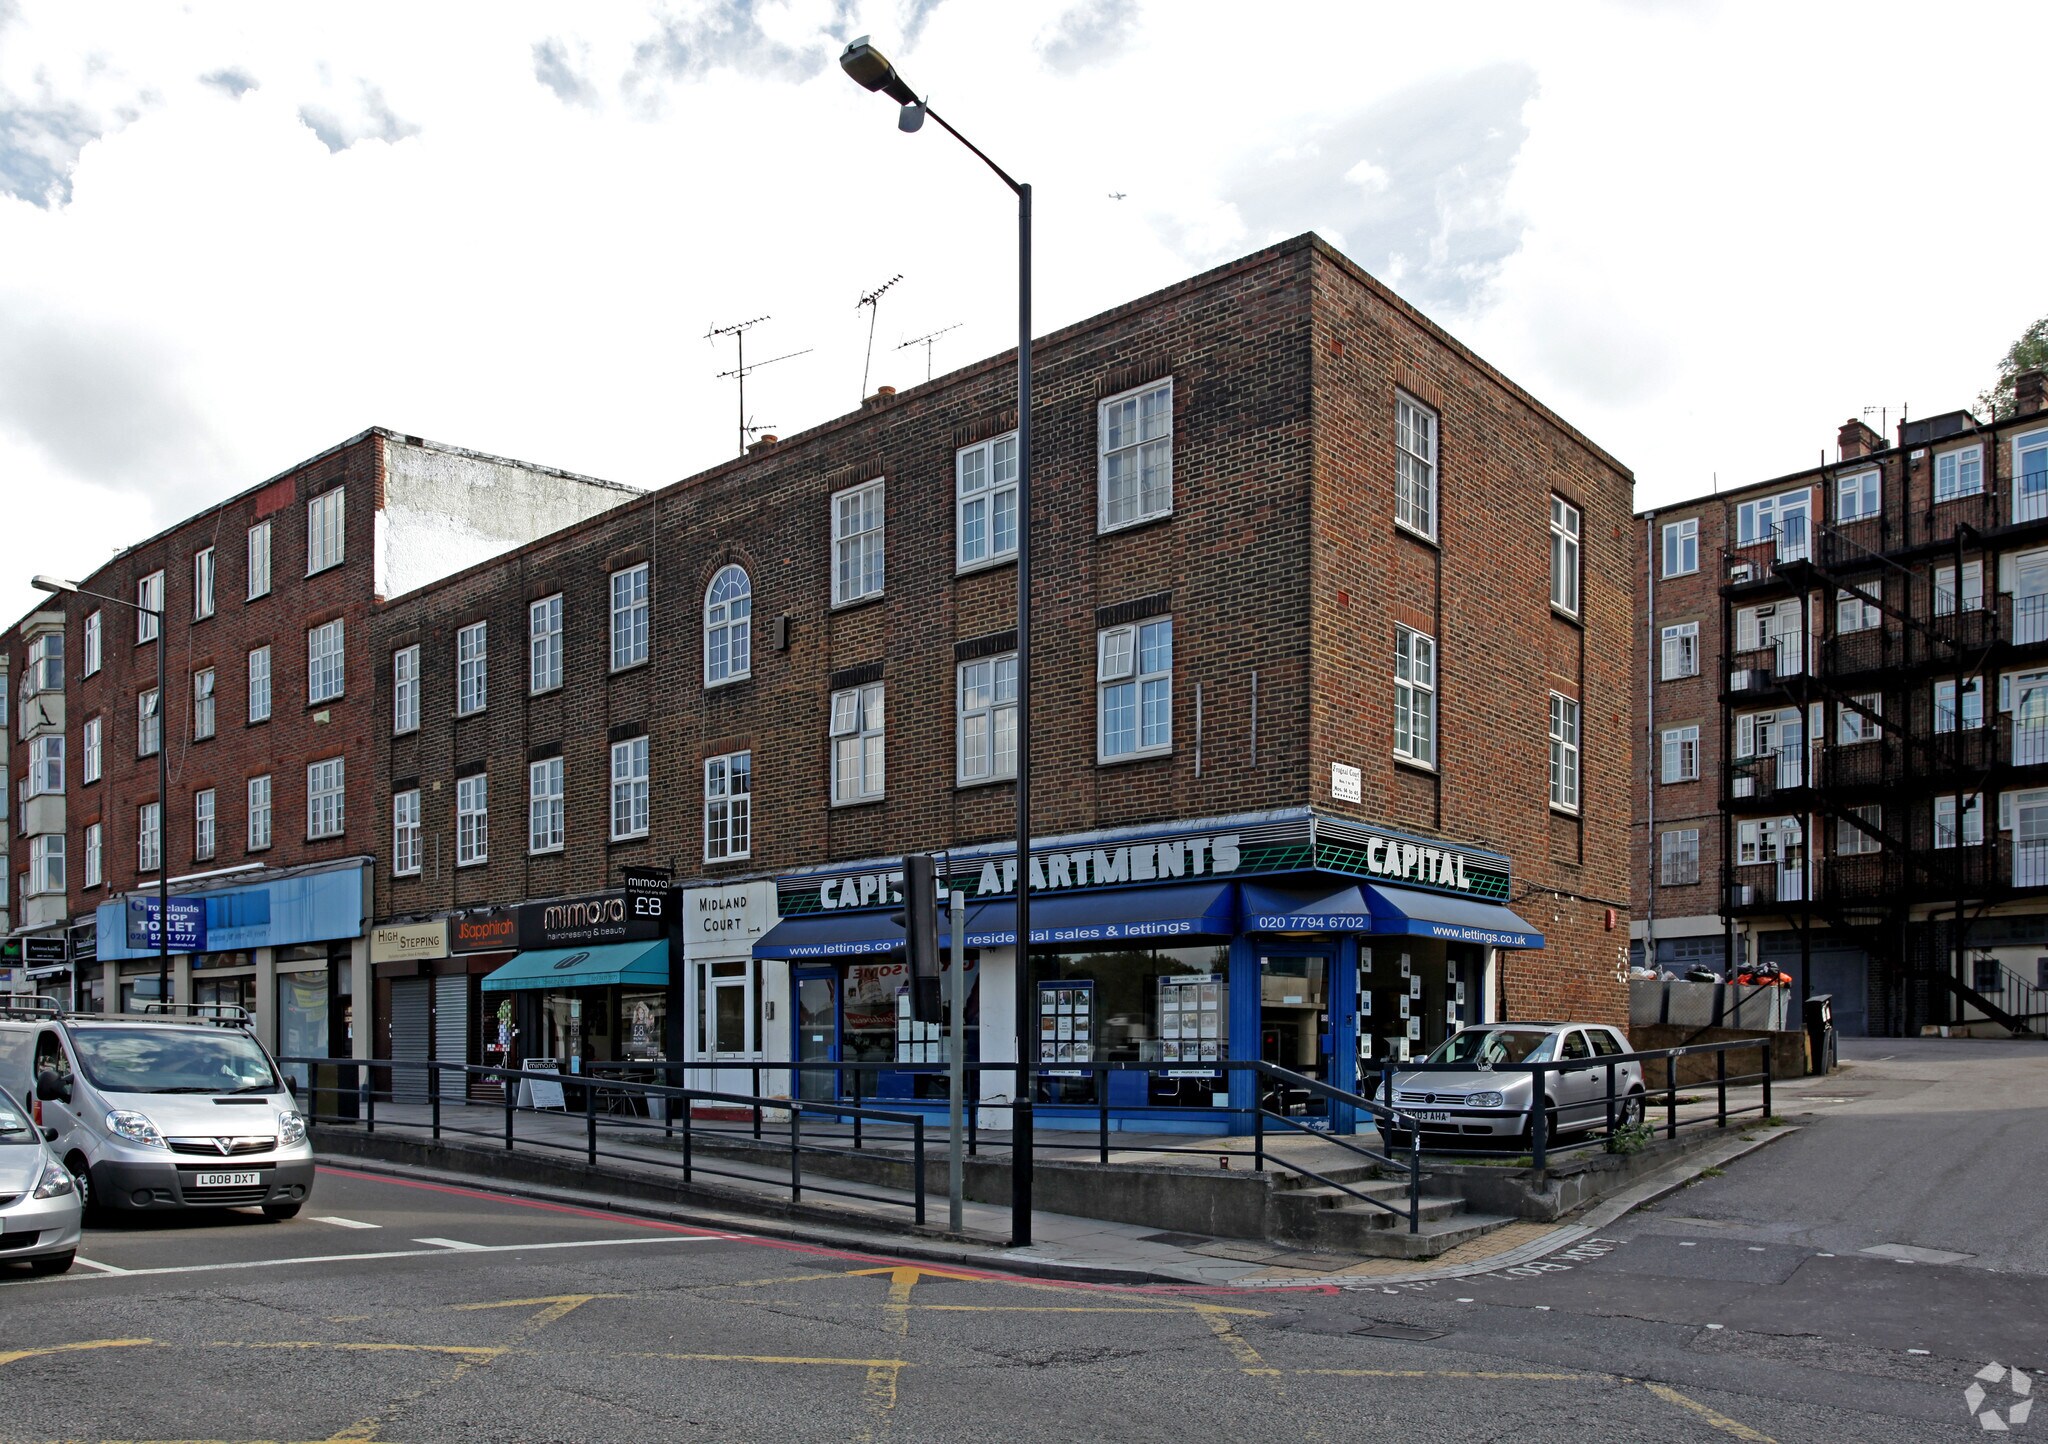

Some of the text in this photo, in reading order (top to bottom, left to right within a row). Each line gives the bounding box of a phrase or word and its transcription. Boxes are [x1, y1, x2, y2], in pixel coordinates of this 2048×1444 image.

[977, 834, 1240, 895] APARTMENTS
[1367, 837, 1470, 889] CAPITAL
[628, 877, 668, 889] mimosa
[820, 868, 949, 909] CAPITL
[131, 900, 200, 913] Groelands
[635, 896, 662, 916] £8
[544, 898, 627, 930] mimosa
[137, 921, 195, 932] TO LET
[1259, 917, 1364, 928] 020 7794 6702
[150, 933, 172, 941] 871
[175, 934, 197, 942] 9777
[547, 926, 627, 940] hairdressing & beauty
[967, 920, 1191, 945] resideial sales & lettings
[1432, 925, 1526, 946] www.lettings.co.uk
[789, 940, 906, 955] www.lettings.co
[633, 1024, 645, 1037] £8
[1429, 1112, 1447, 1120] AHA
[234, 1173, 256, 1184] DXT
